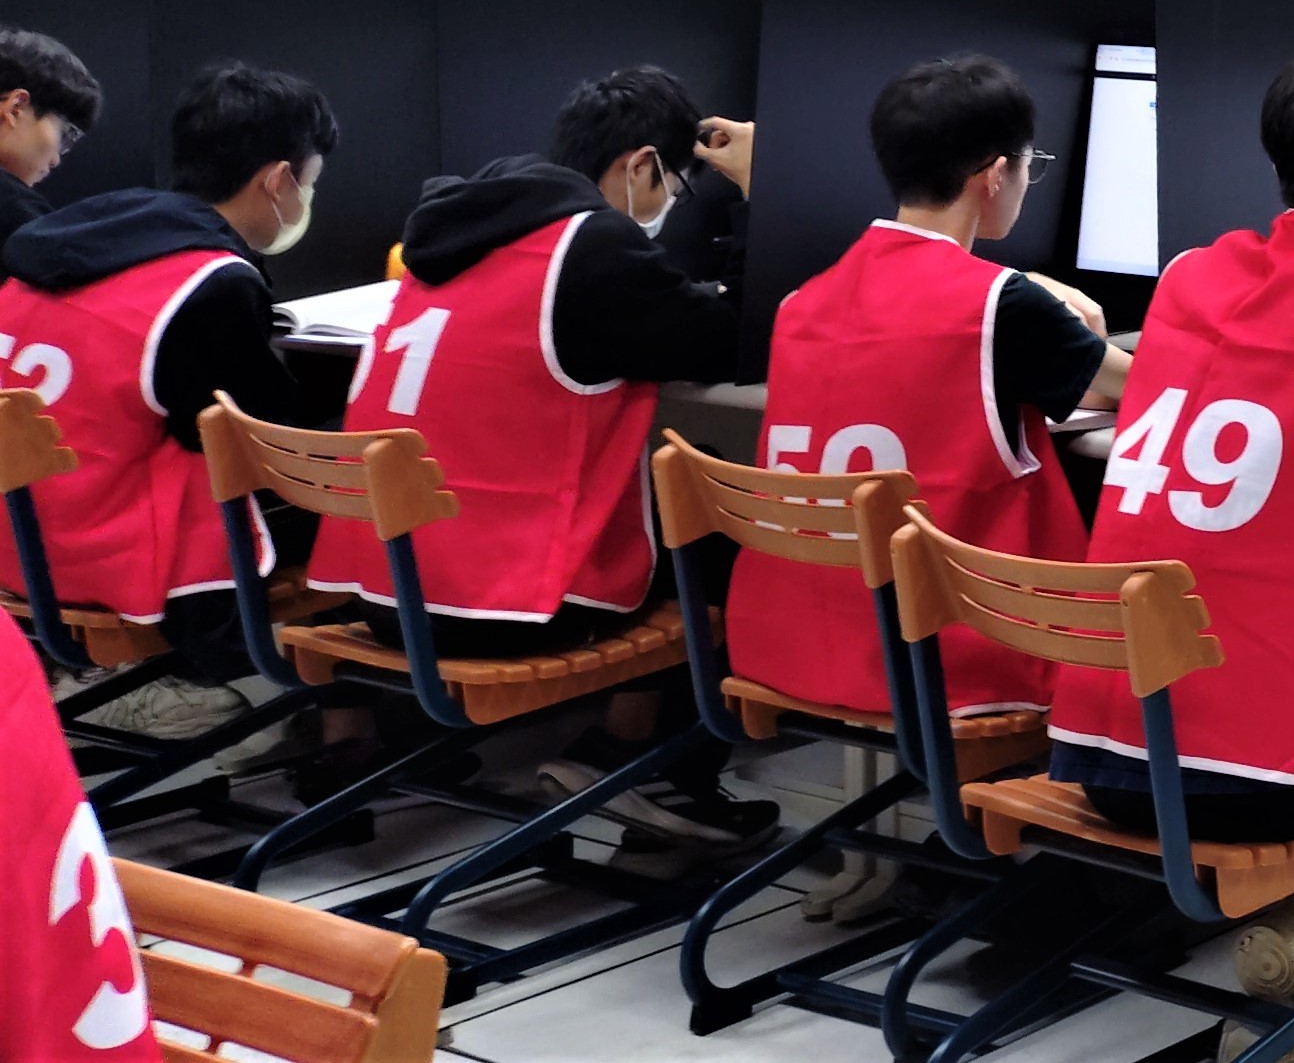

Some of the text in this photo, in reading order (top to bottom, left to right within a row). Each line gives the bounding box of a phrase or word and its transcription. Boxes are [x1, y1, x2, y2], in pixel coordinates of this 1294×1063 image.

[0, 332, 73, 406] 2
[383, 306, 452, 416] 1
[1103, 387, 1284, 532] 49
